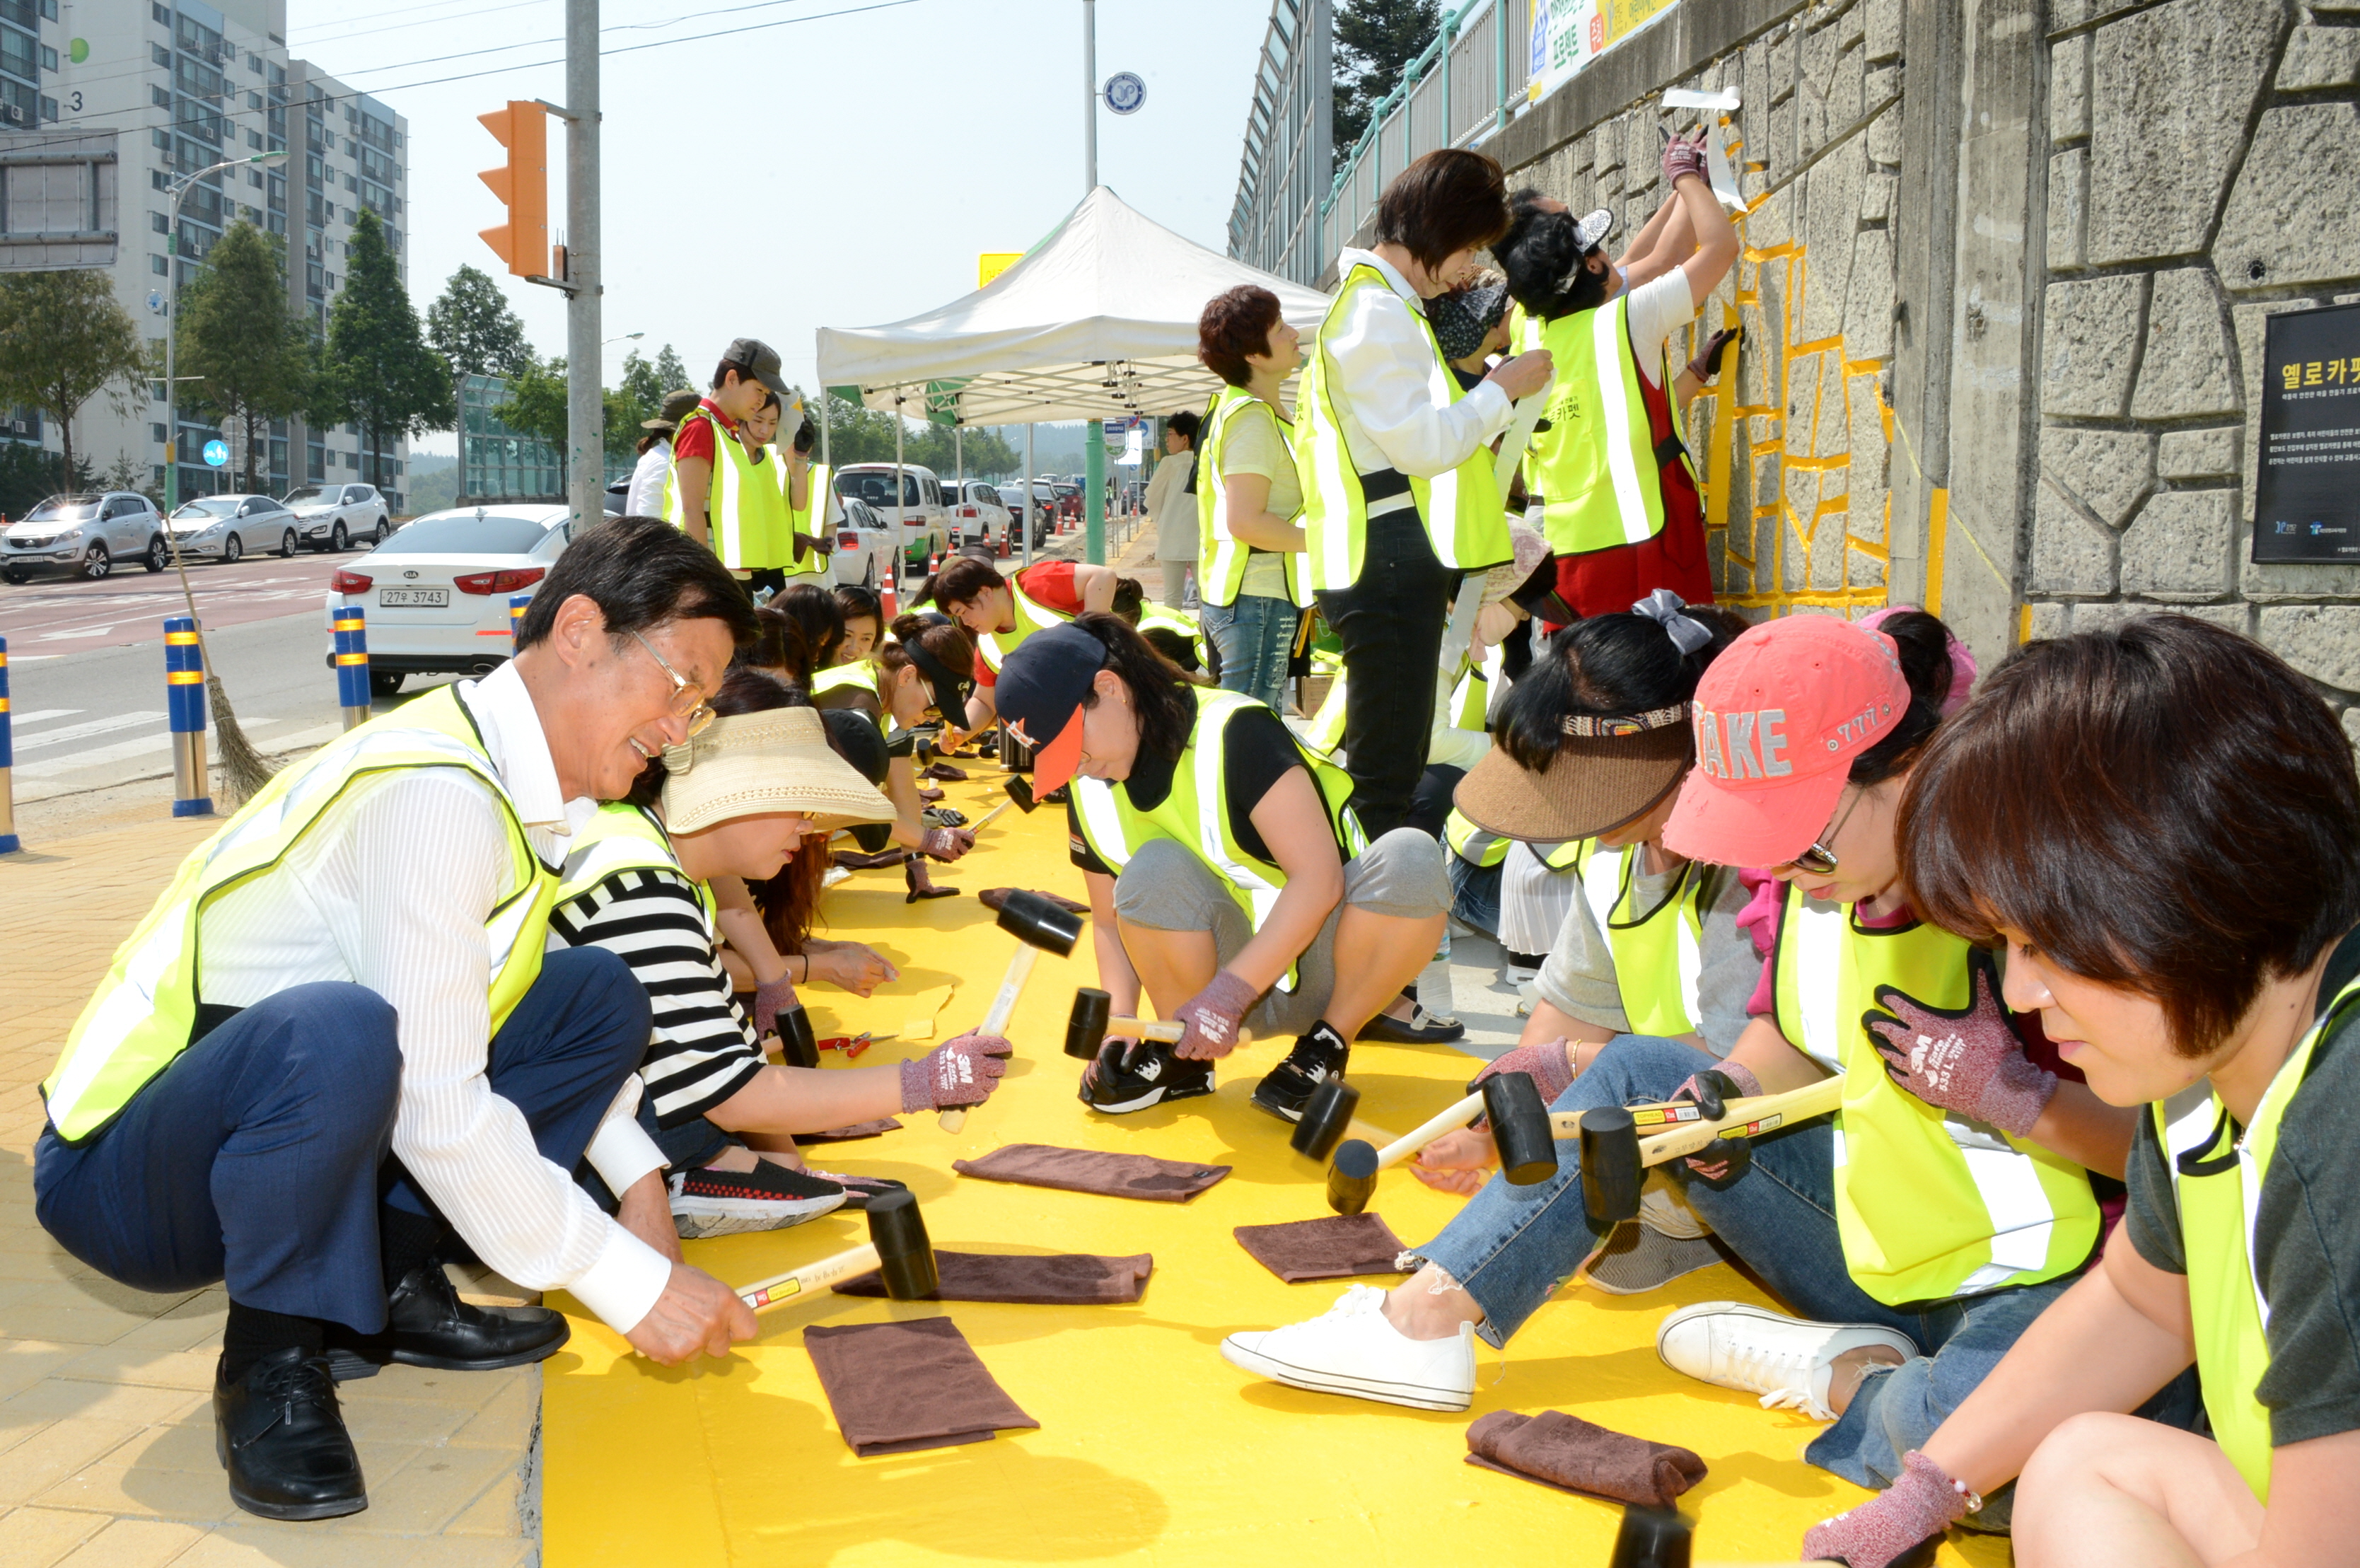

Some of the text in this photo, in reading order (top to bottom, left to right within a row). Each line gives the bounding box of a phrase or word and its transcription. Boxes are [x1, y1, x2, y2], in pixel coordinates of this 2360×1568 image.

[1554, 23, 1579, 70] 프로젝트
[71, 91, 83, 112] 3
[2329, 388, 2345, 397] 만들기
[1543, 402, 1581, 425] 로카펫
[387, 592, 441, 603] 27우 3743
[1837, 707, 1877, 742] 777
[1692, 700, 1793, 779] TAKE
[1911, 1034, 1933, 1074] 3M
[1929, 1040, 1944, 1064] Safe
[957, 1053, 973, 1084] 3M
[1938, 1071, 1951, 1091] 533
